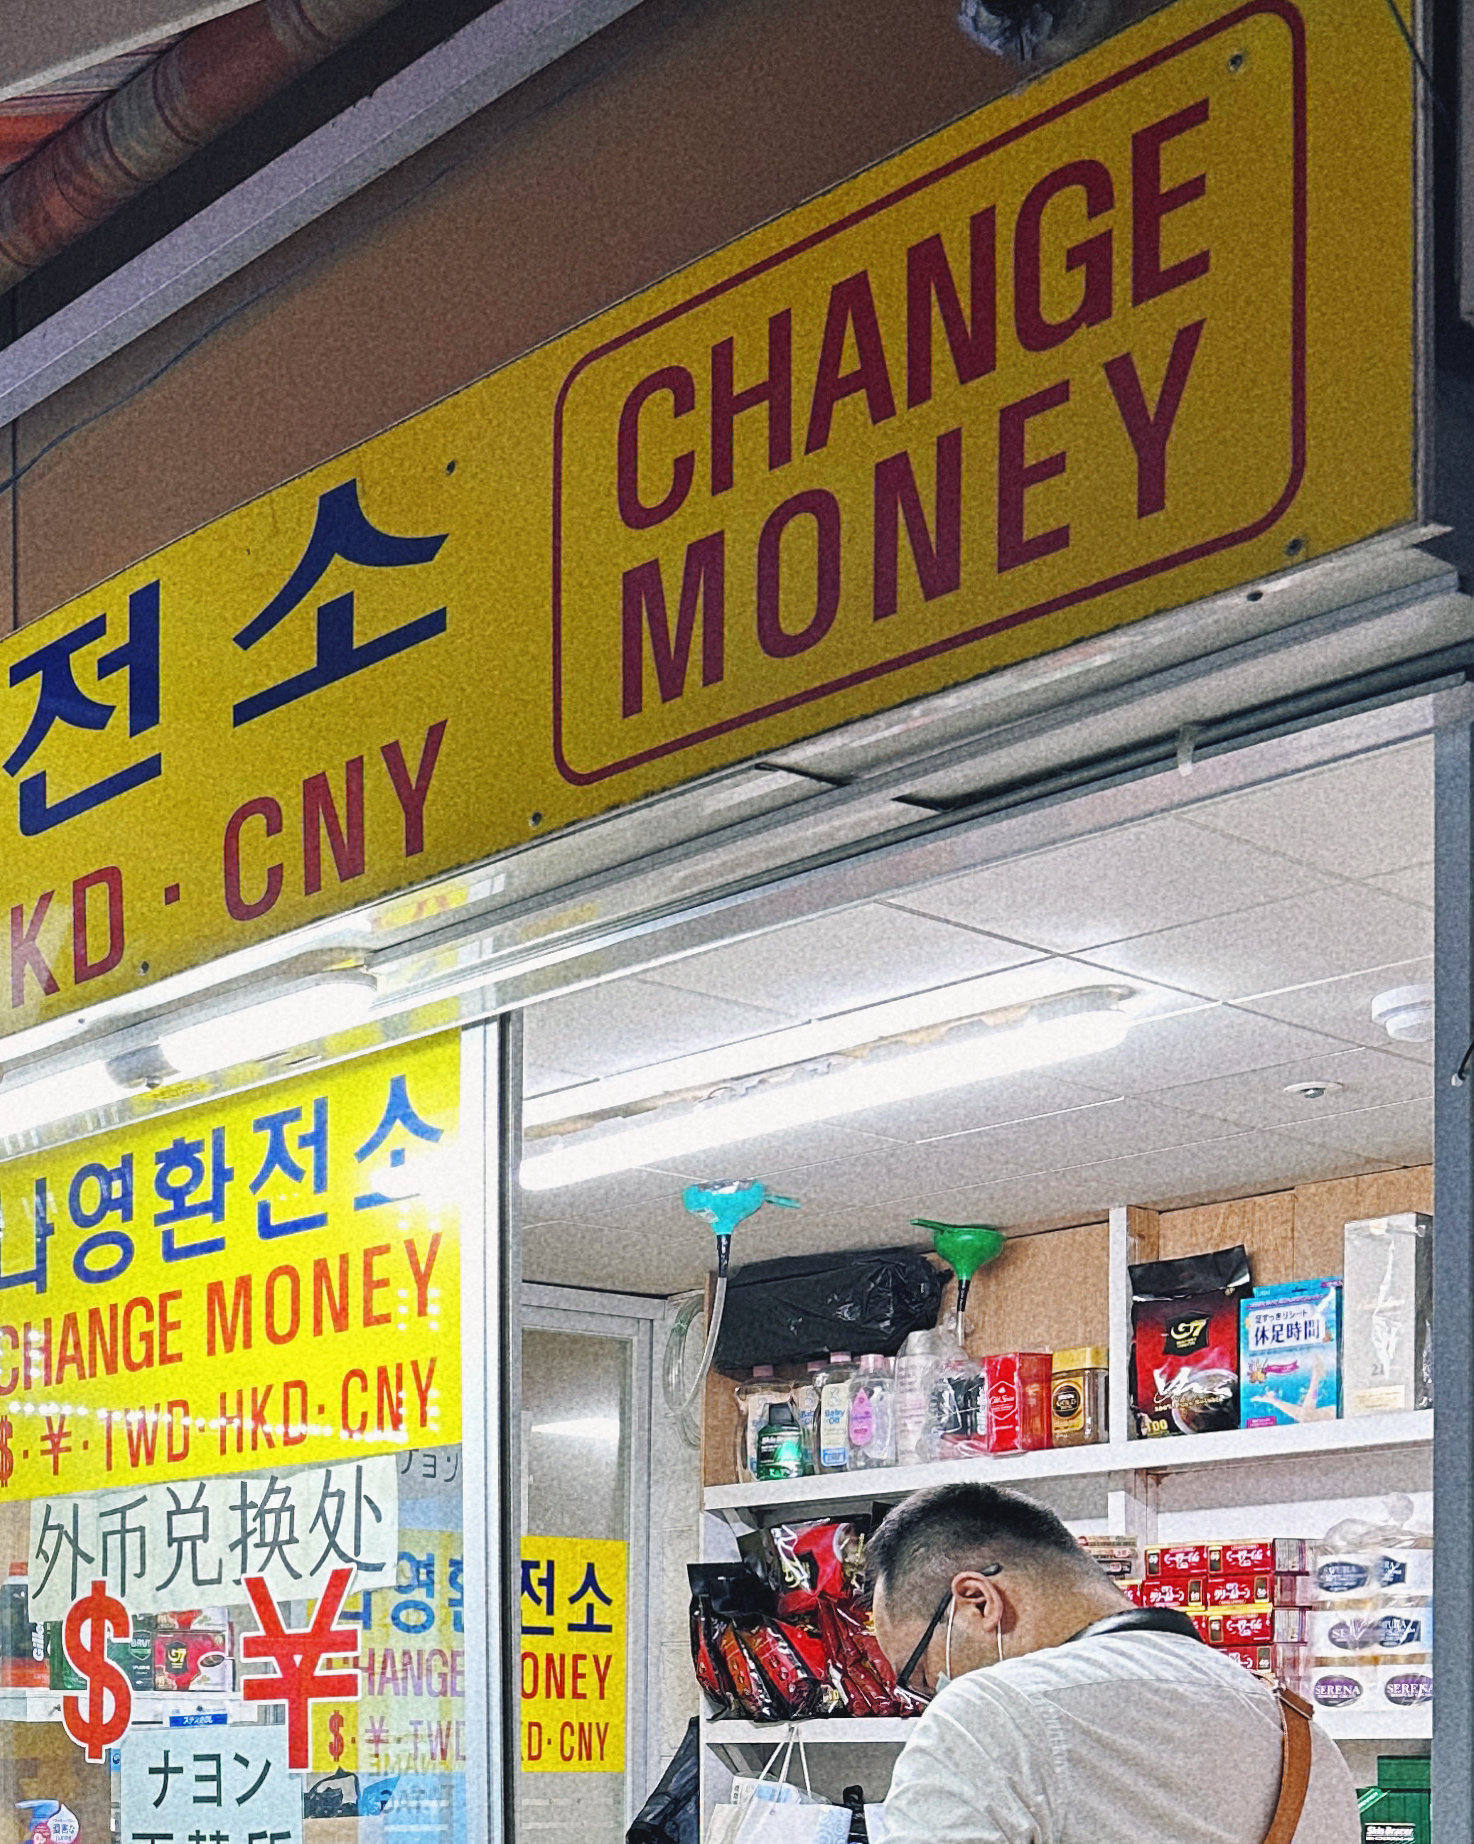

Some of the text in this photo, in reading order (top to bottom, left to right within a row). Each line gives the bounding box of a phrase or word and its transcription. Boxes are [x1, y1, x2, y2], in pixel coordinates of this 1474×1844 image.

[614, 98, 1212, 533] CHANGE
[619, 318, 1206, 716] MONEY
[220, 718, 448, 922] CNY
[206, 1231, 444, 1357] MONEY
[1254, 1319, 1321, 1347] 休足時間
[28, 1464, 388, 1602] 外币兑换处
[61, 1567, 358, 1770] $ ¥
[338, 1646, 614, 1700] HANGE ONEY
[1314, 1684, 1361, 1695] SERENA
[148, 1749, 271, 1809] ナヨン
[558, 1721, 611, 1762] CNY
